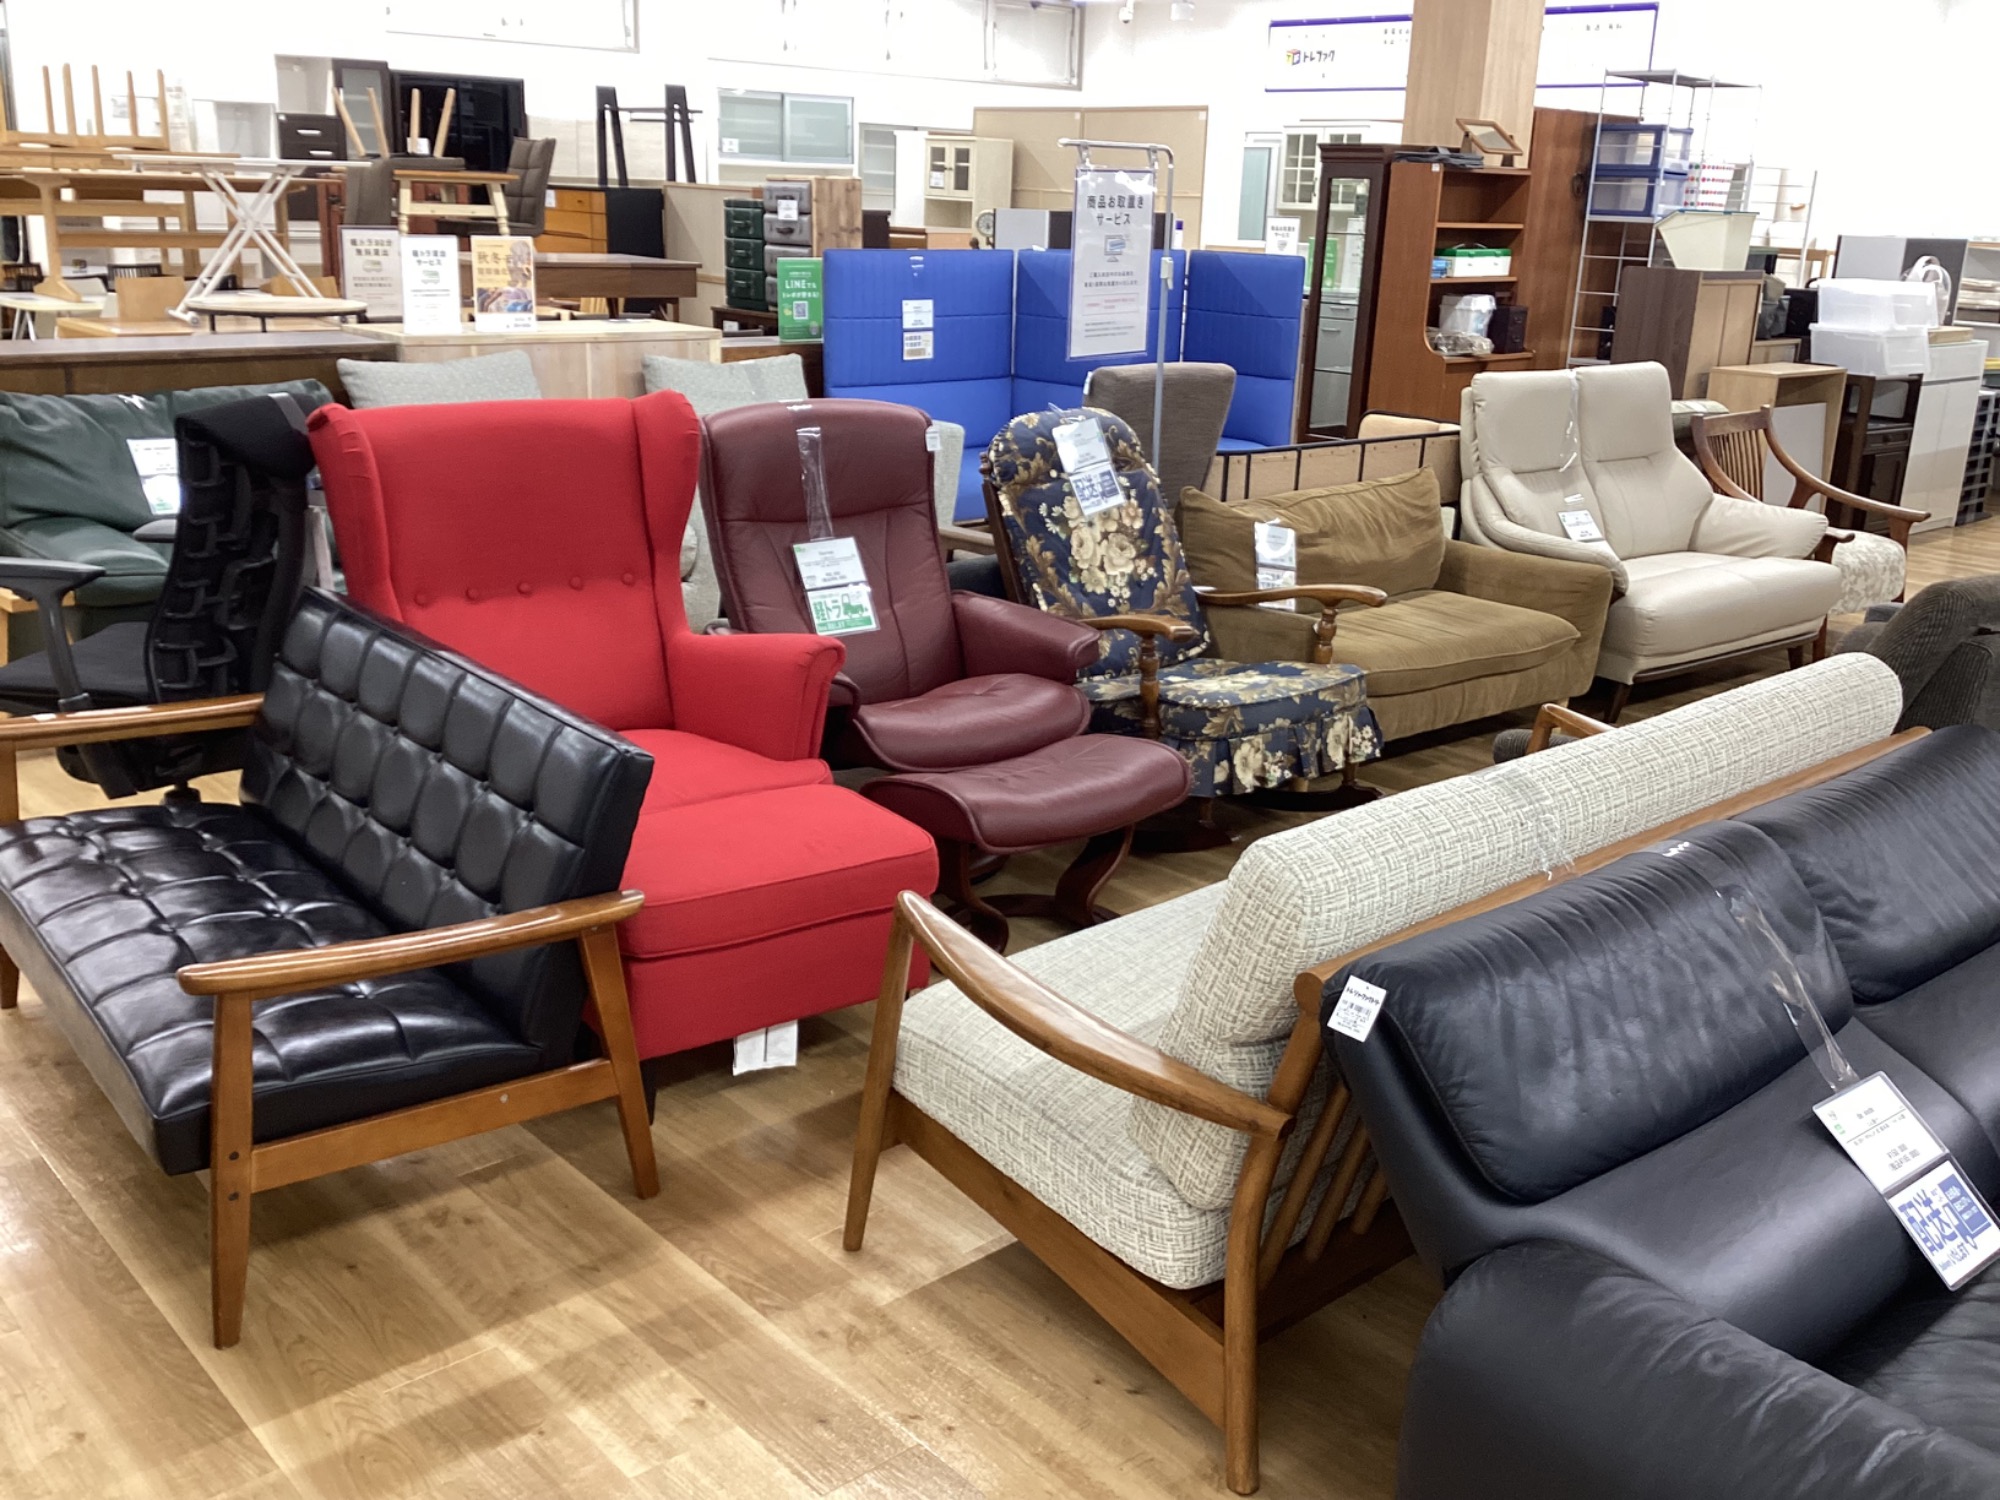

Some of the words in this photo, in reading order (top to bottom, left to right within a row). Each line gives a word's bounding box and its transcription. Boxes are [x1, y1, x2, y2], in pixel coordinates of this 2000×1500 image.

[1303, 50, 1335, 62] トレファク
[1087, 195, 1143, 209] 商品お取置き
[1096, 213, 1130, 226] サービス
